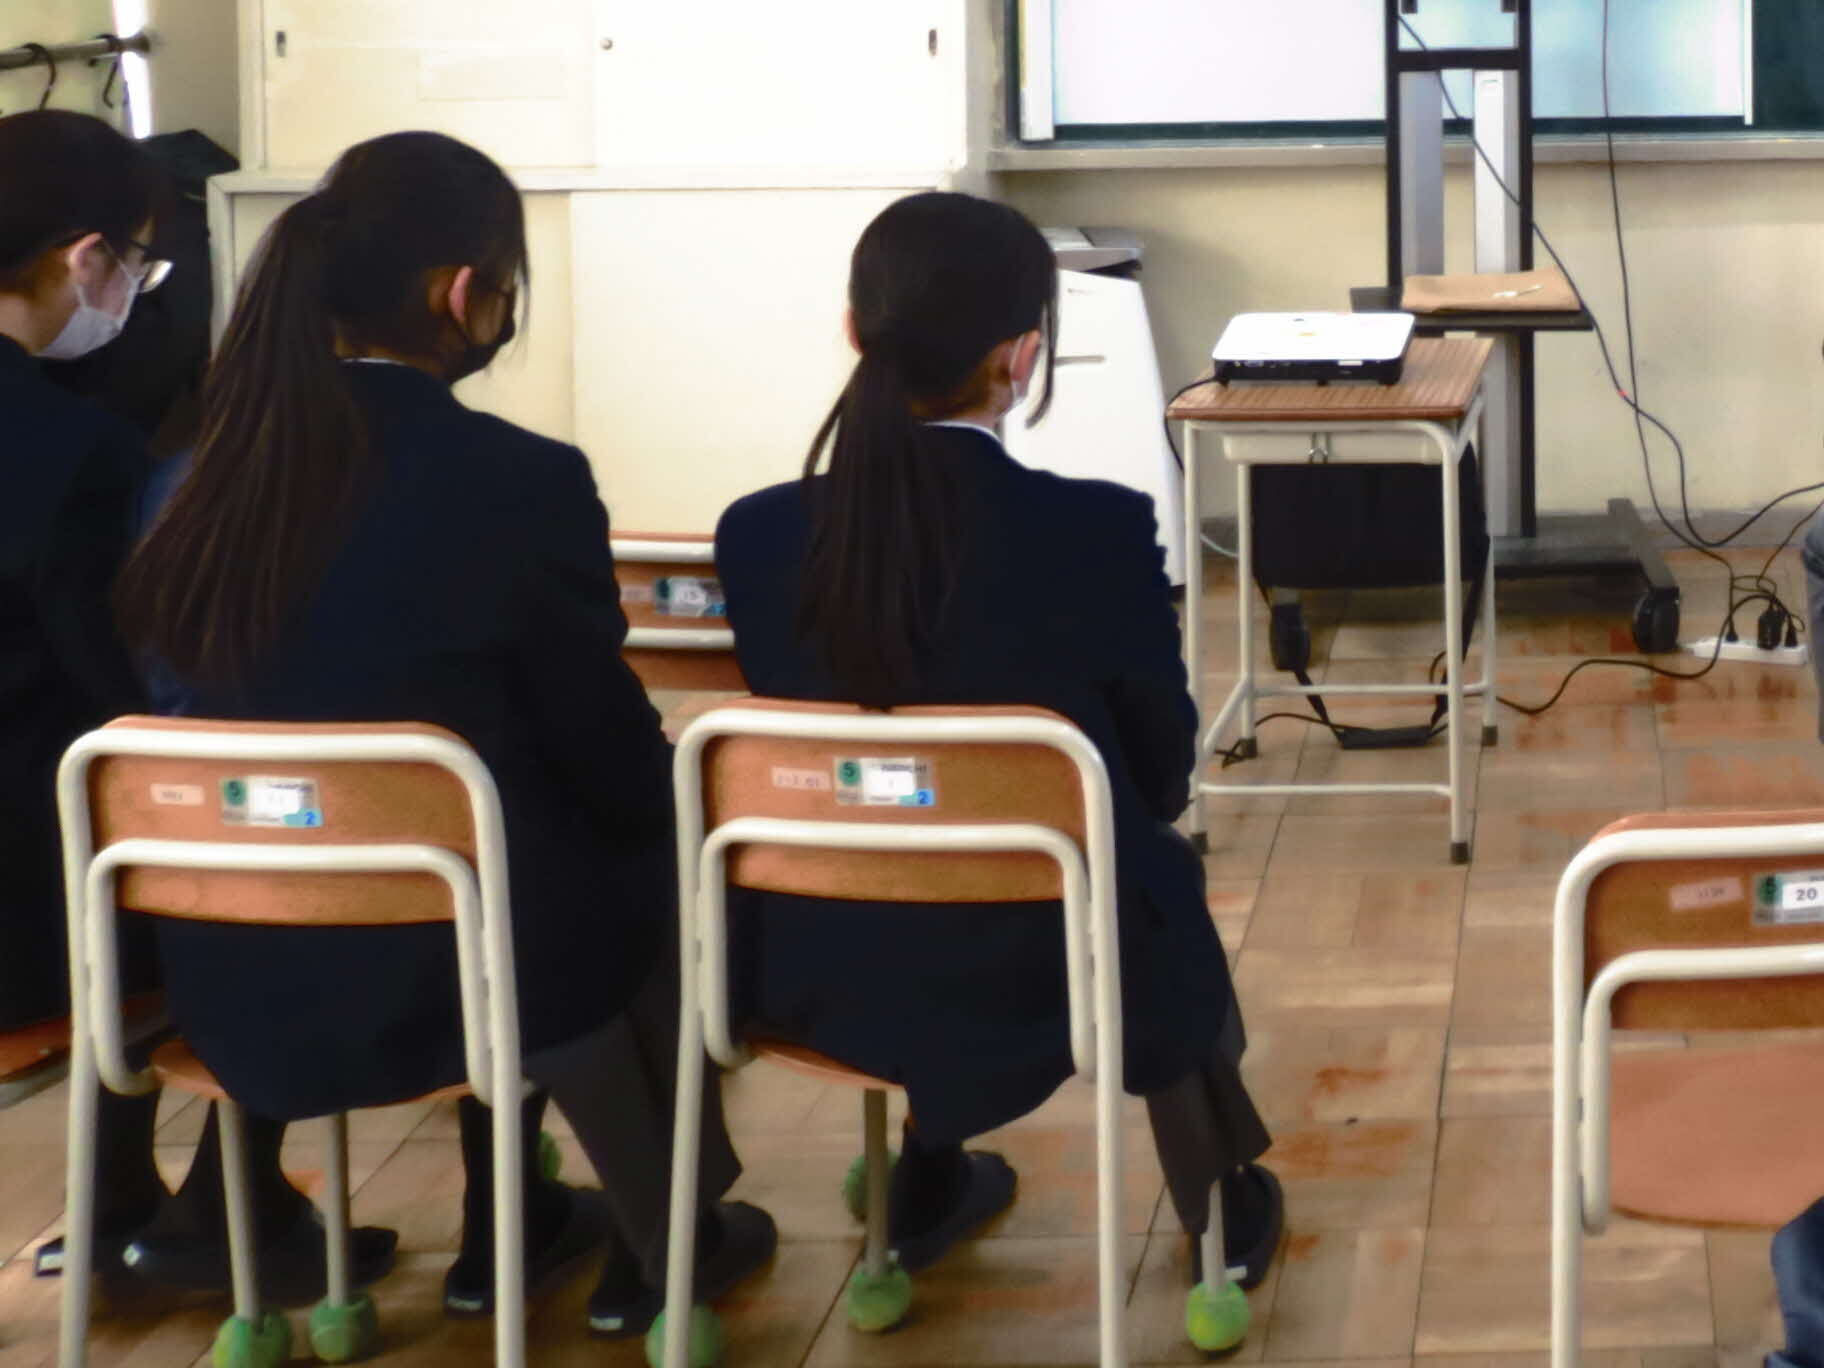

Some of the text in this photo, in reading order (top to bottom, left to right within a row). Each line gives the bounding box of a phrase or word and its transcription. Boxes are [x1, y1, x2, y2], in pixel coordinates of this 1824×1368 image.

[918, 791, 929, 804] 2
[305, 811, 316, 825] 2
[1796, 888, 1817, 901] 20
